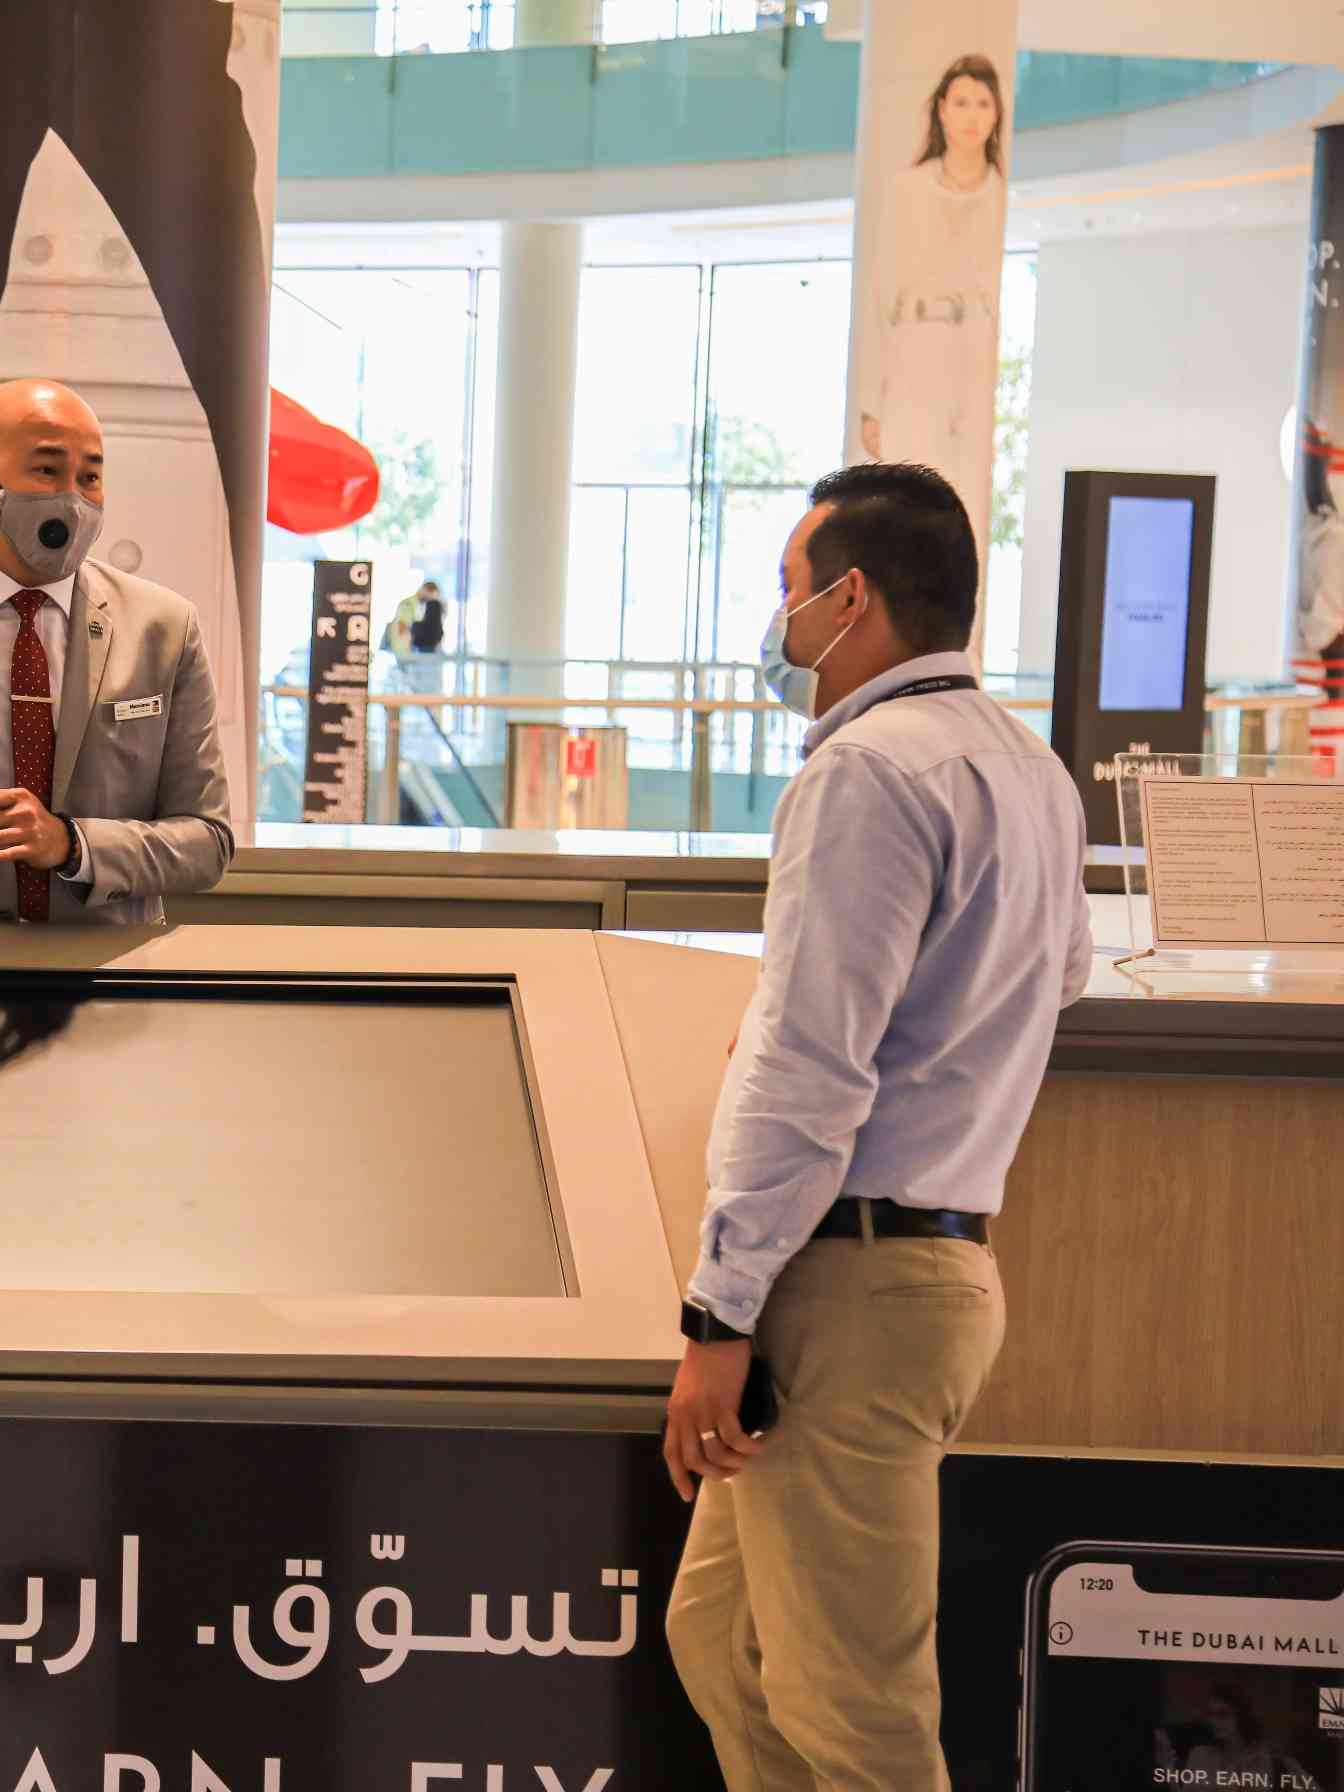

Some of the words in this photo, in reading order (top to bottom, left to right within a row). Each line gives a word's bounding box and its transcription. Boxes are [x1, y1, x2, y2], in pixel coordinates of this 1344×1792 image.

[1079, 1577, 1114, 1592] 12:20
[197, 1535, 639, 1684] تسوّق.
[1137, 1629, 1183, 1648] THE
[1192, 1631, 1264, 1652] DUBAI
[1274, 1636, 1340, 1655] MALL
[1153, 1767, 1209, 1785] SHOP.
[1216, 1771, 1273, 1788] EARN.
[1280, 1774, 1317, 1790] FLY.
